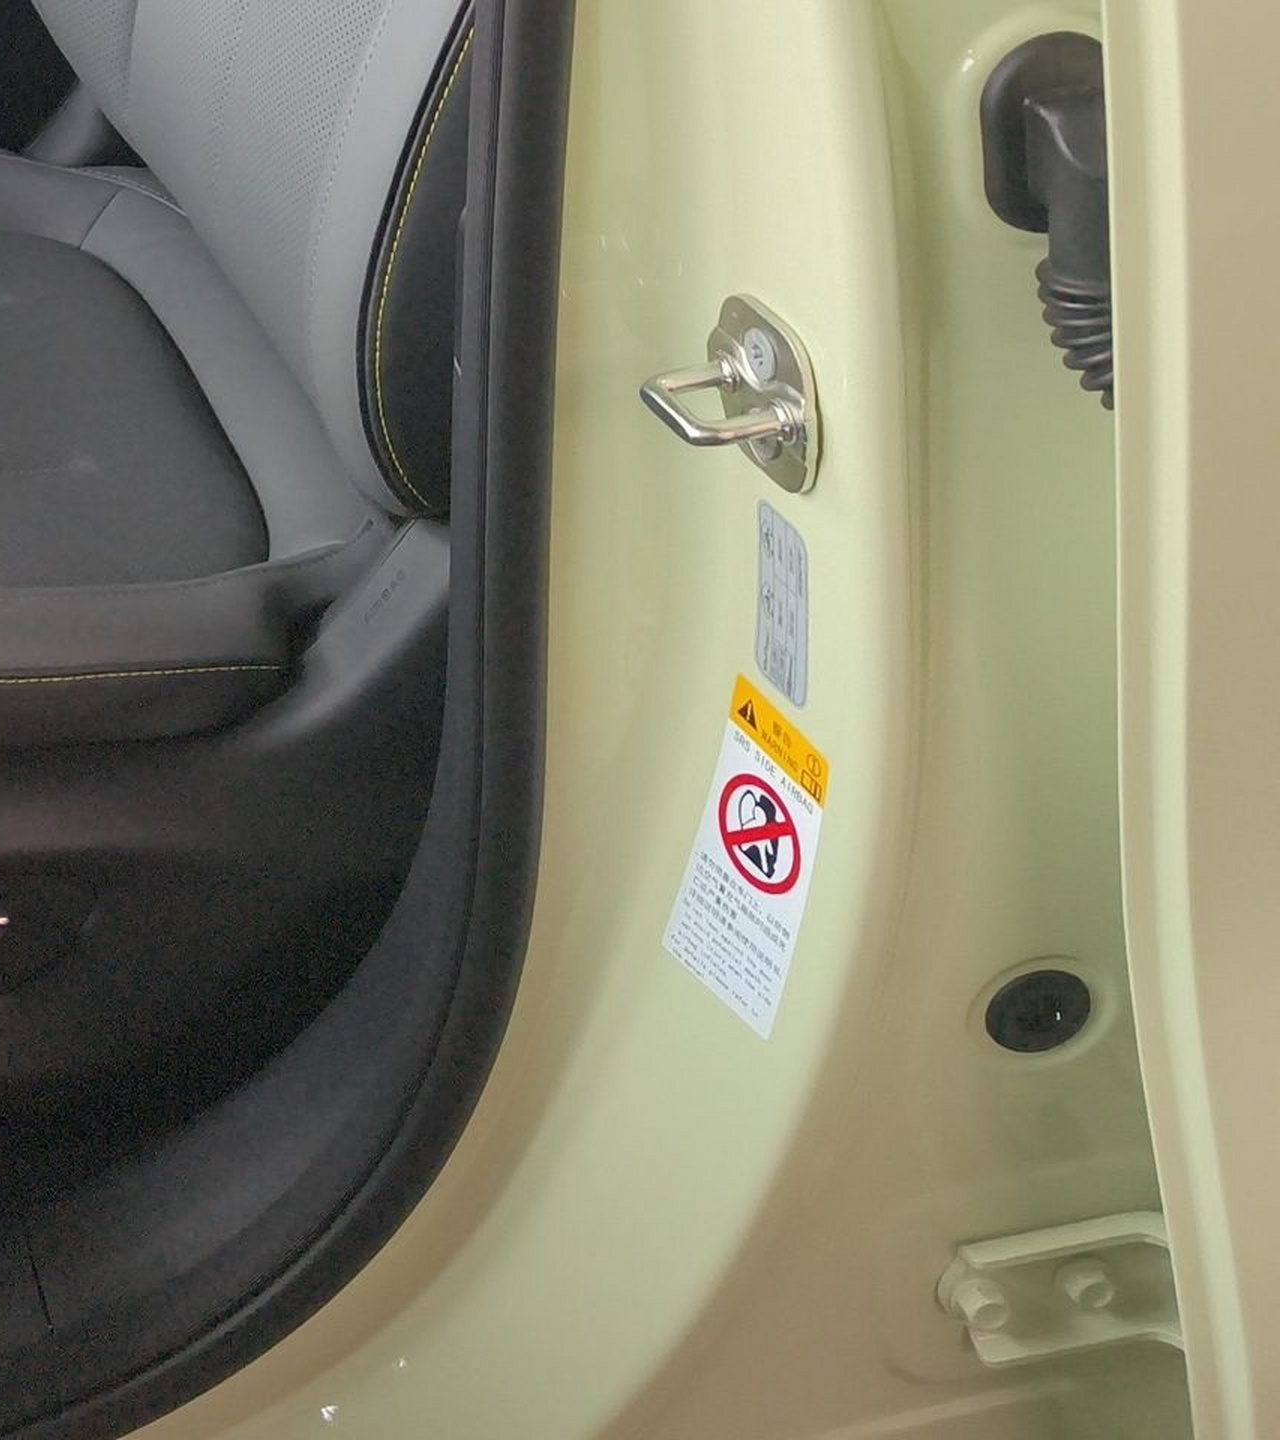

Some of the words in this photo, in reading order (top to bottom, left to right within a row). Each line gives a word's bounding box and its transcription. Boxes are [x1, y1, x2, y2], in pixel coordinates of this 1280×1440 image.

[733, 728, 751, 753] SRS
[753, 748, 777, 779] SIDE
[780, 774, 814, 816] AIRBAG
